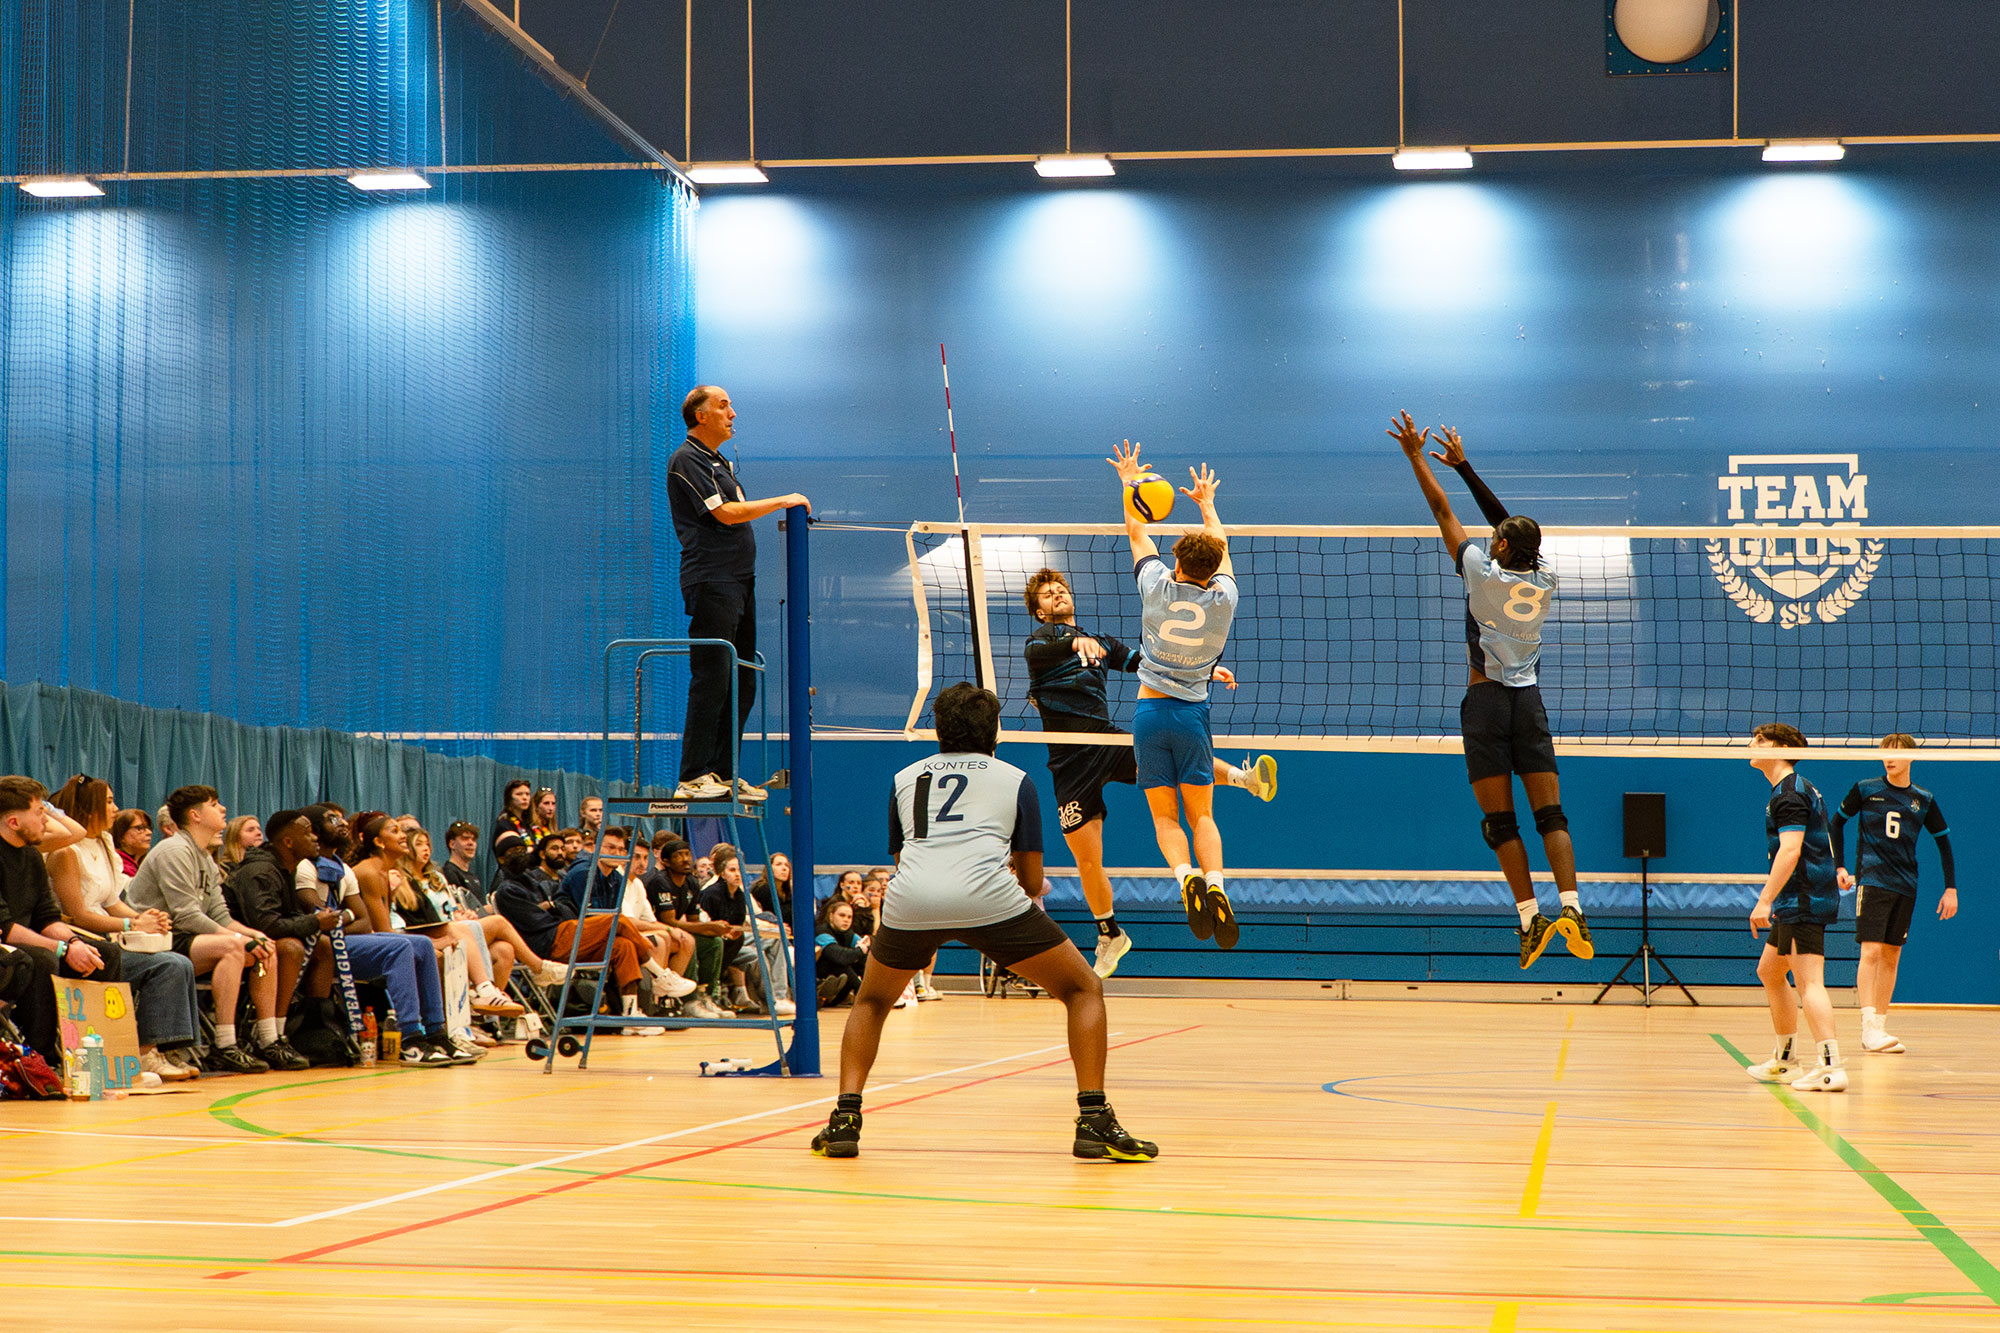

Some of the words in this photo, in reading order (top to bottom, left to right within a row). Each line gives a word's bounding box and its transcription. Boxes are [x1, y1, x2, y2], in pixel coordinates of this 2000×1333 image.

[1718, 474, 1868, 520] TEAM
[1729, 522, 1861, 566] GLOS
[1503, 580, 1545, 622] 8
[1158, 601, 1206, 647] 2
[923, 761, 989, 771] KONTES
[1885, 811, 1901, 839] 6
